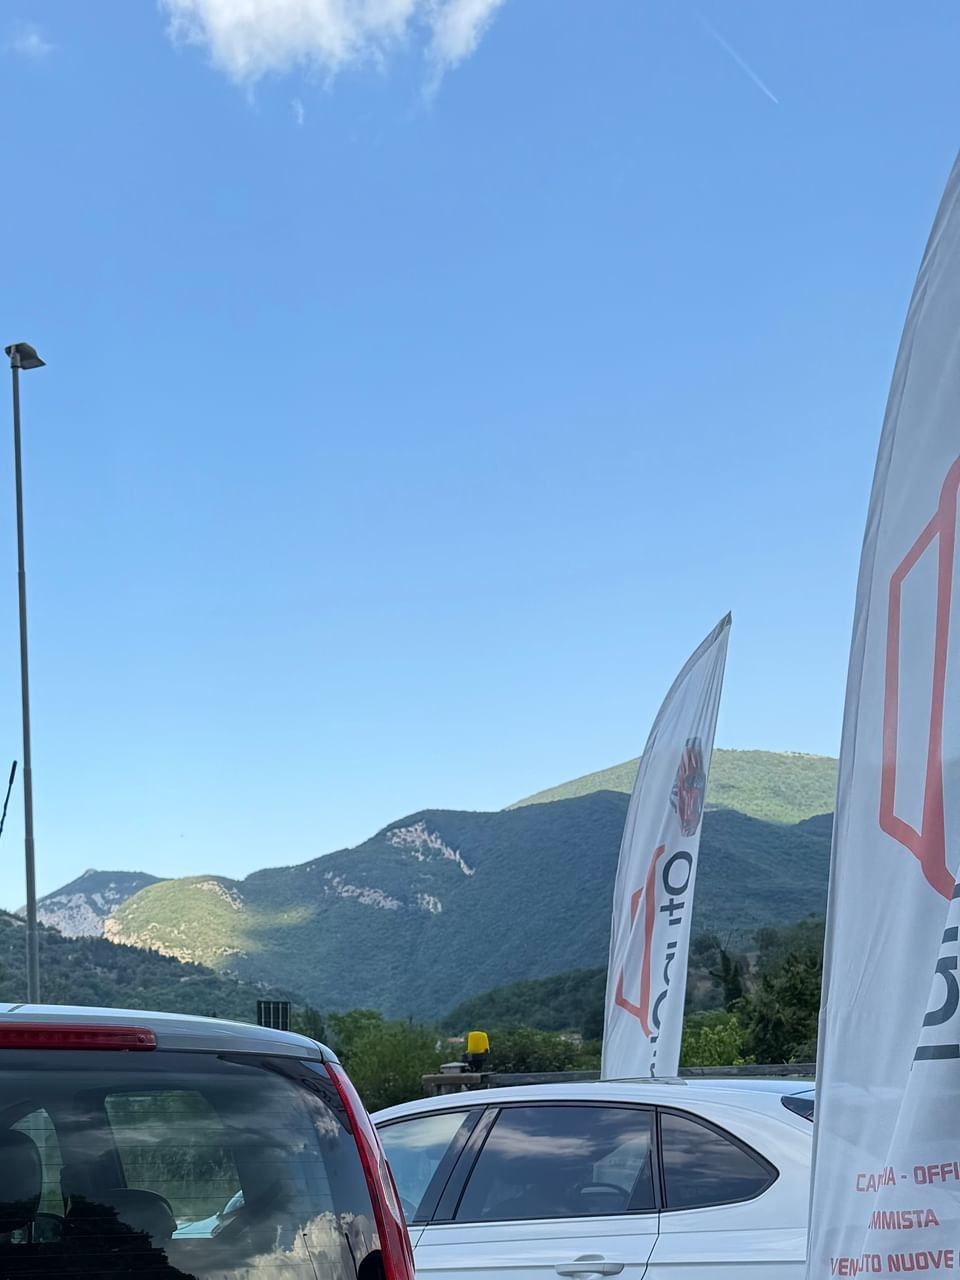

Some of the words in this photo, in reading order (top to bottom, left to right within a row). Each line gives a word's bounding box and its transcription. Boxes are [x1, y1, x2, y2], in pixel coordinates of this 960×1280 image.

[913, 1161, 960, 1185] OFFI
[868, 1208, 940, 1231] MMISTA
[887, 1249, 954, 1273] NUOVE
